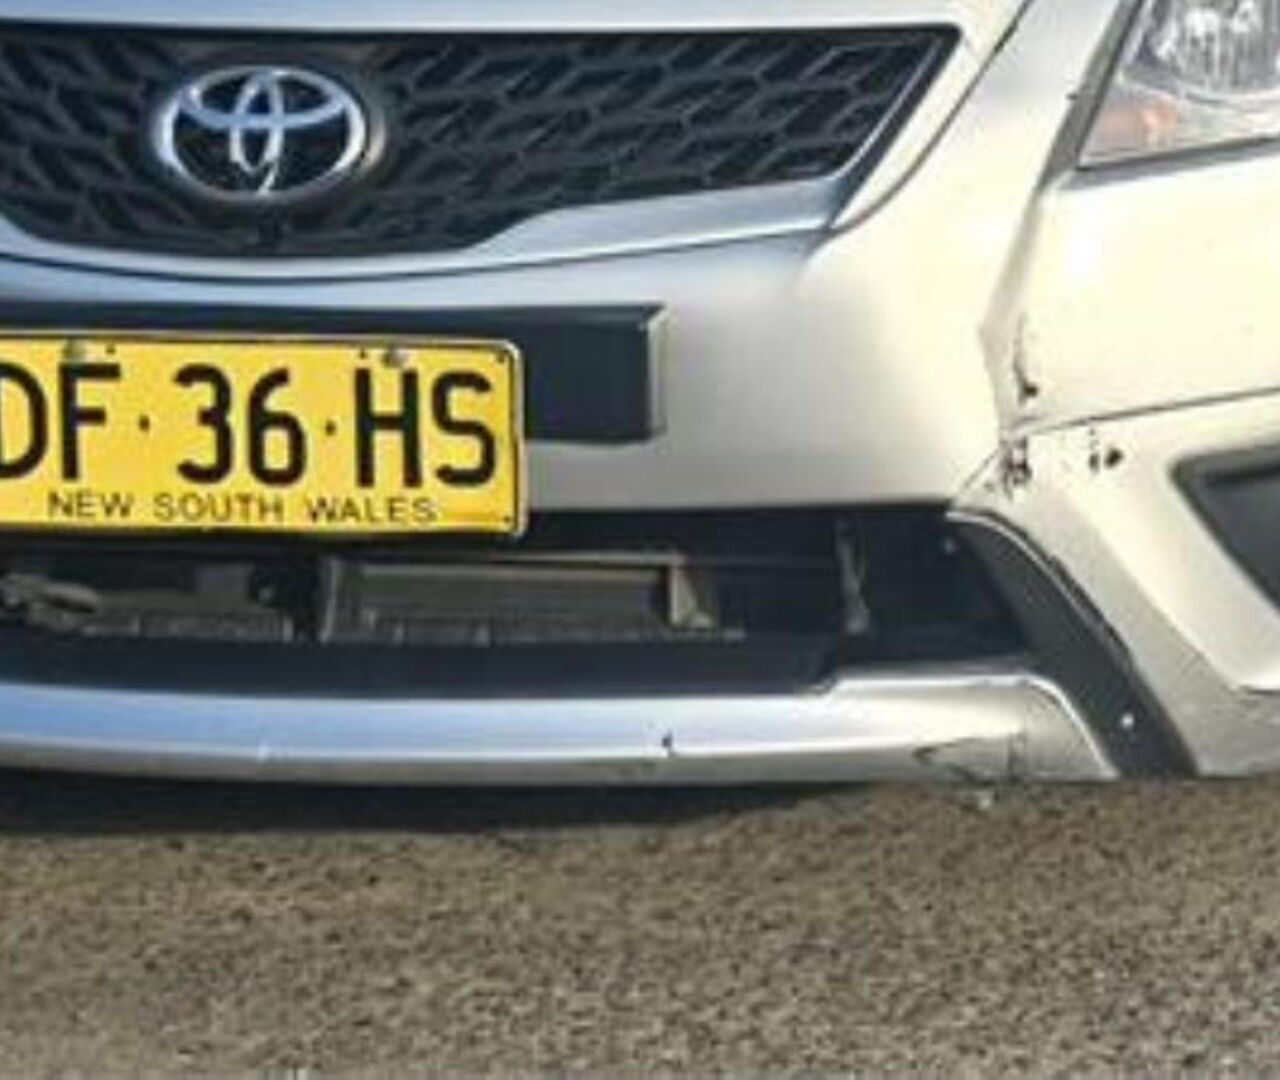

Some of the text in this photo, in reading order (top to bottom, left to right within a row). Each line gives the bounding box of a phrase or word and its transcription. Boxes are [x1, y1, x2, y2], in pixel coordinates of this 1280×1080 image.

[49, 493, 437, 522] NEW SOUTH WALES
